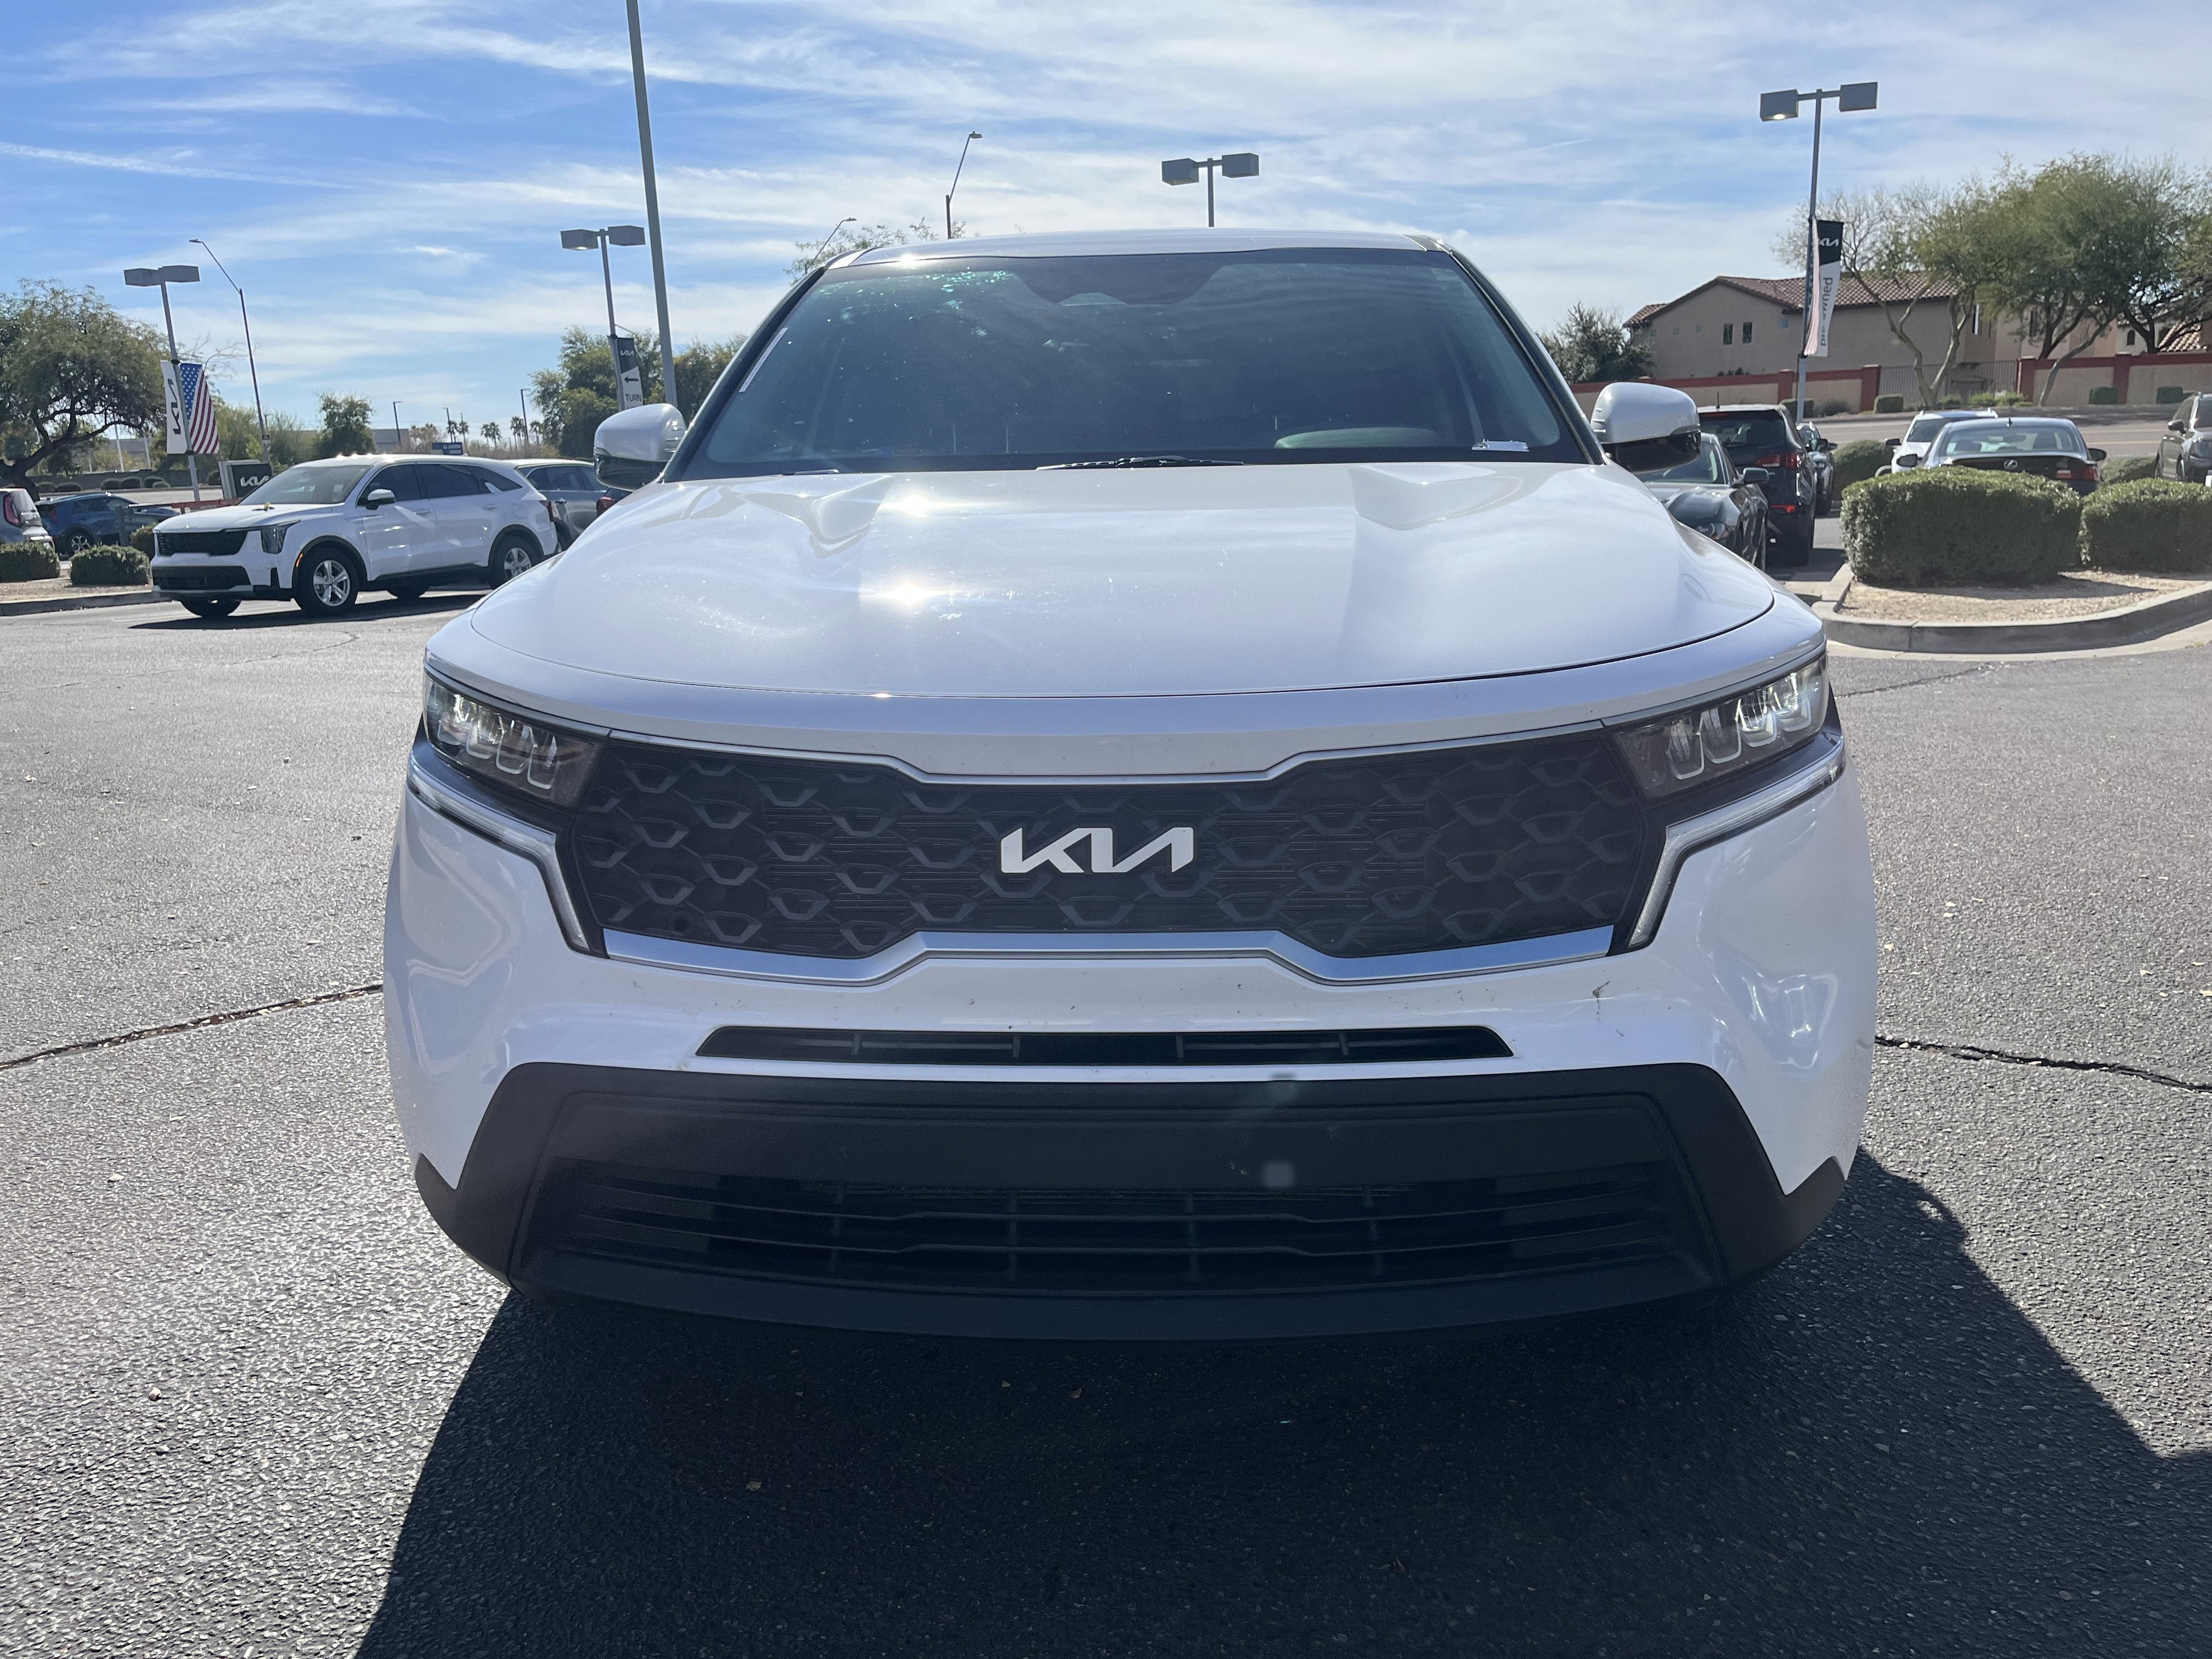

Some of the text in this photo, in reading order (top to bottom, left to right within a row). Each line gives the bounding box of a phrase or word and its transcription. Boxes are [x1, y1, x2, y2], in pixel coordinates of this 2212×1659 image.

[168, 379, 181, 434] KIA
[240, 475, 269, 487] KIA
[1001, 827, 1194, 873] KIA
